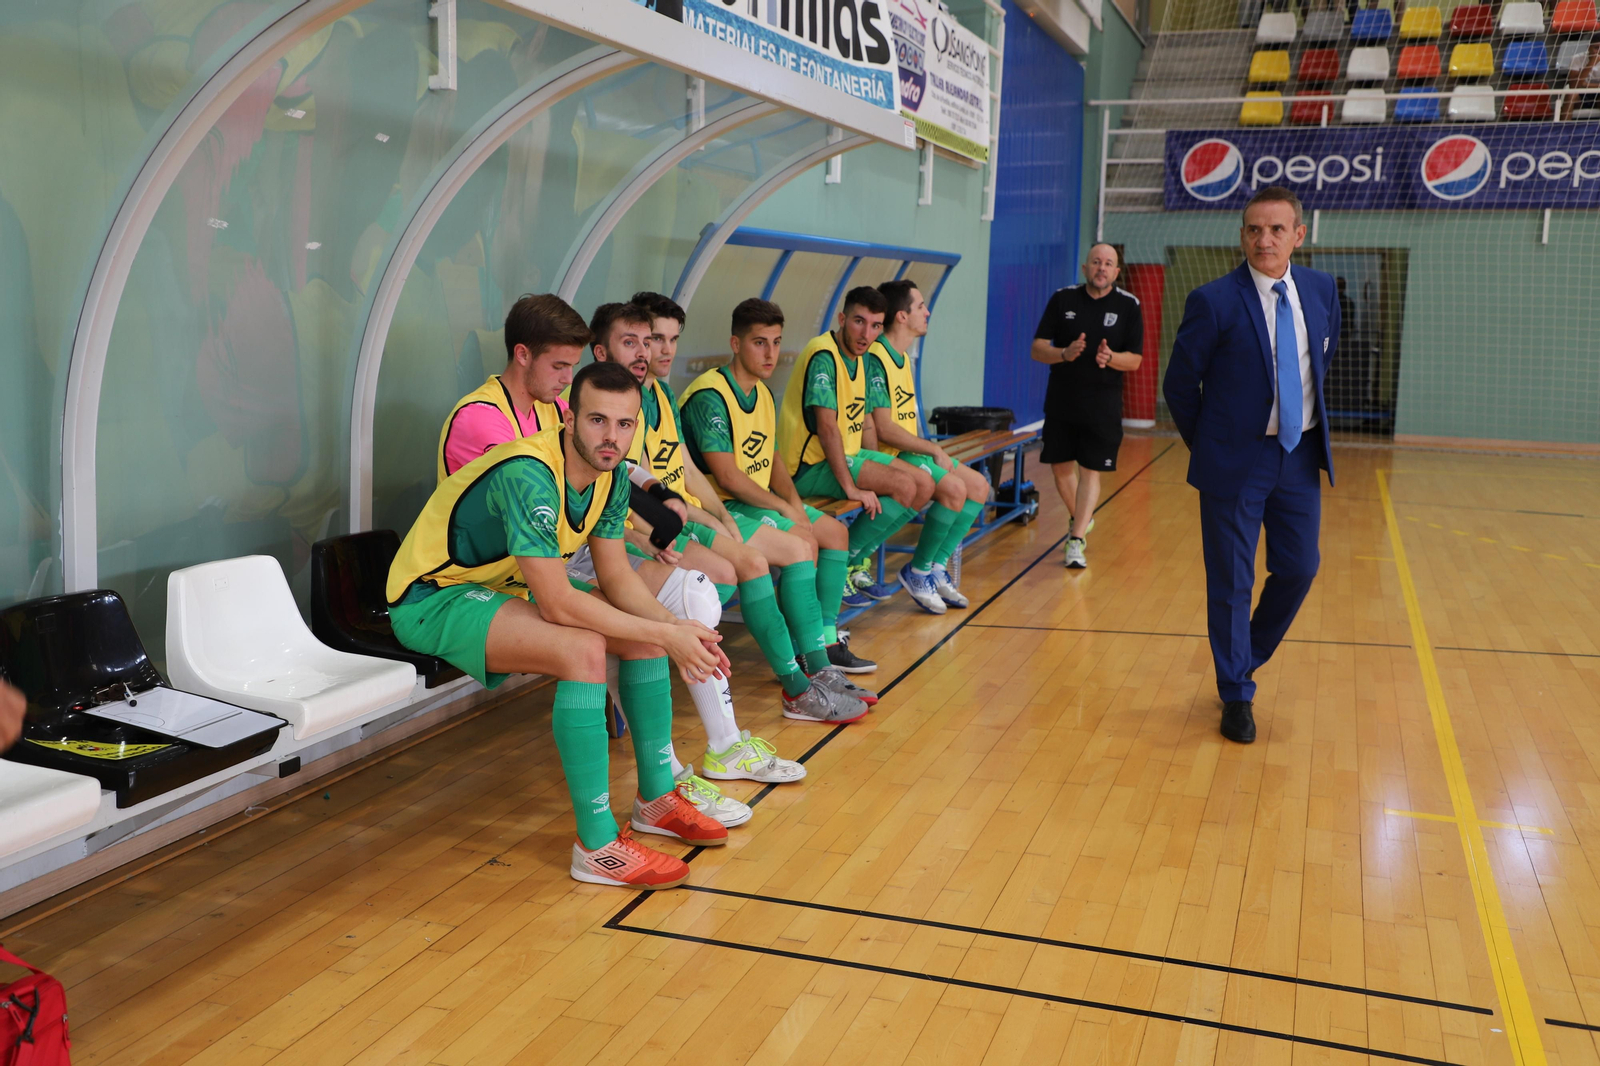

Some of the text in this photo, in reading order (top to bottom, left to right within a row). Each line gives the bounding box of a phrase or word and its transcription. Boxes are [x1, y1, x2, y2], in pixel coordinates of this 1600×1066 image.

[779, 48, 797, 70] DE
[799, 57, 886, 101] FONTANERÍA
[1251, 146, 1383, 190] pepsi
[1500, 150, 1600, 188] pep
